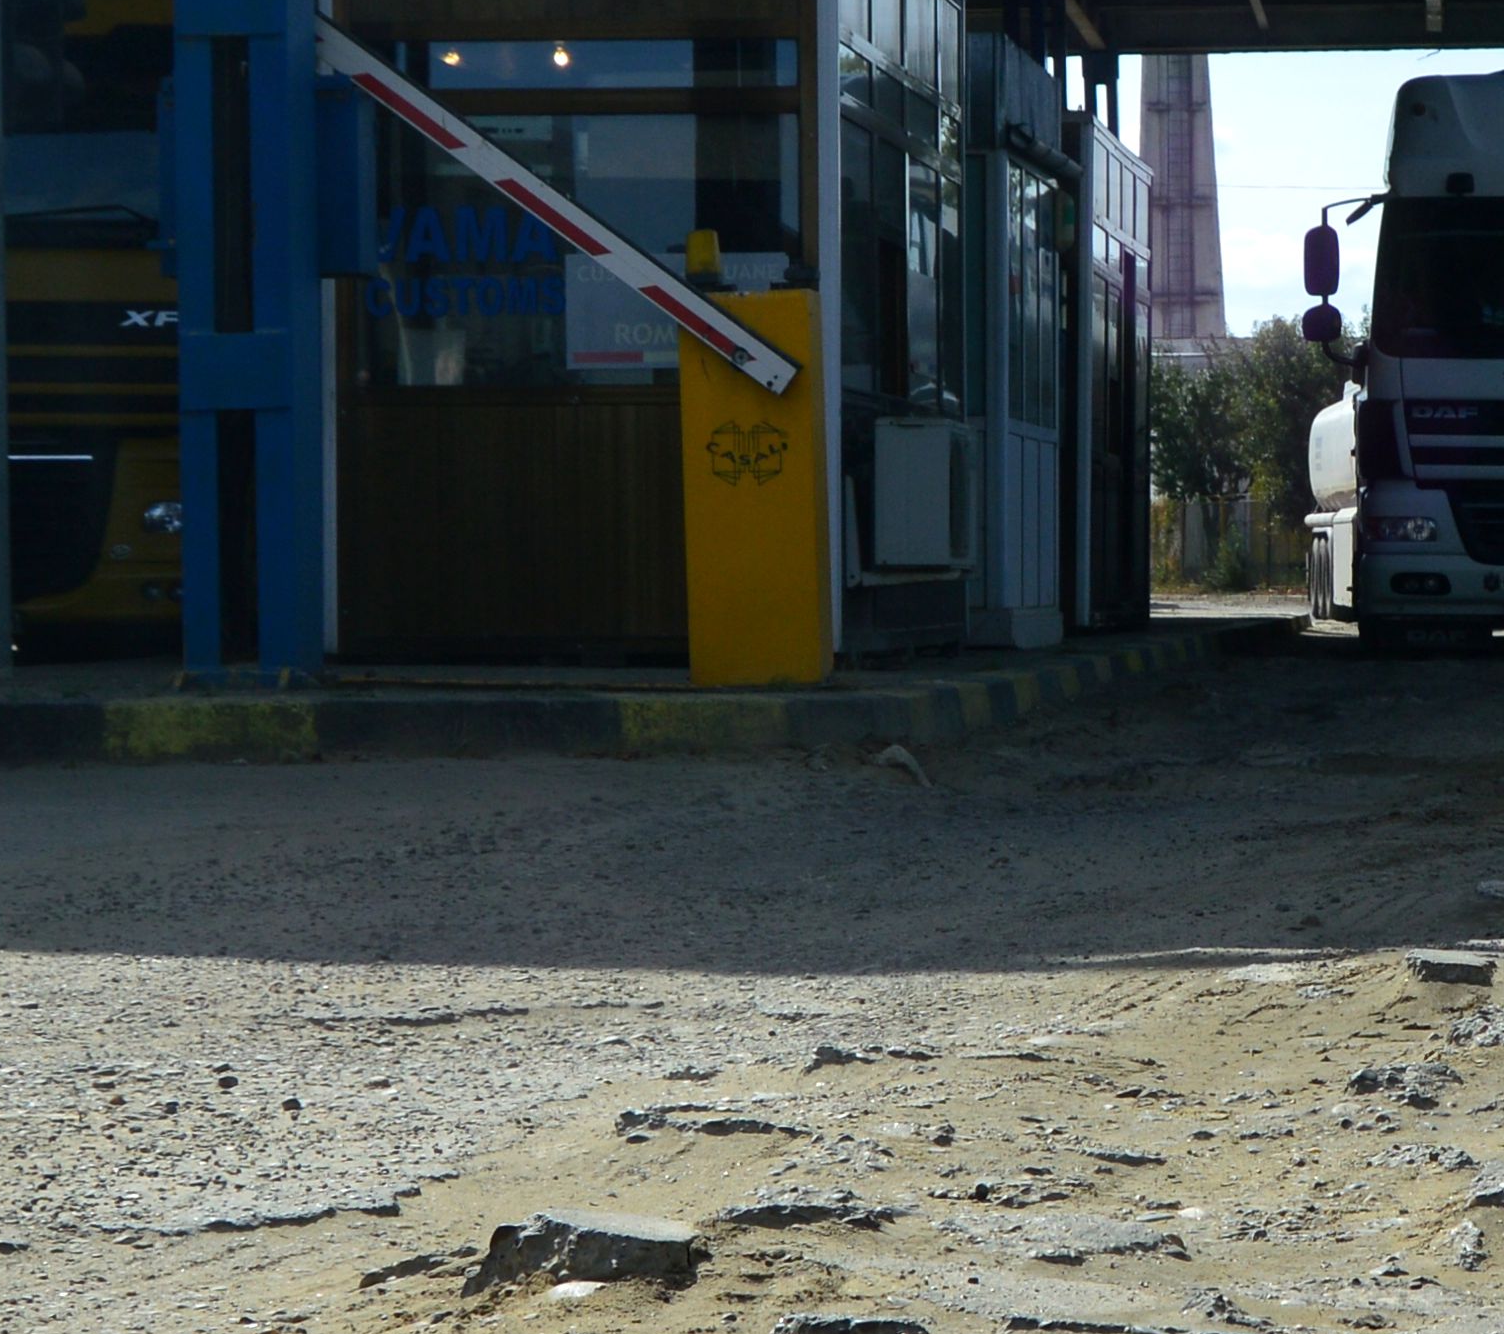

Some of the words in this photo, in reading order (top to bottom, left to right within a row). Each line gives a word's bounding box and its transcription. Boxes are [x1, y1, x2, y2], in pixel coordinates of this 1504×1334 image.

[366, 277, 566, 317] CUSTOMS
[614, 323, 676, 346] ROM
[1411, 406, 1479, 419] DAF
